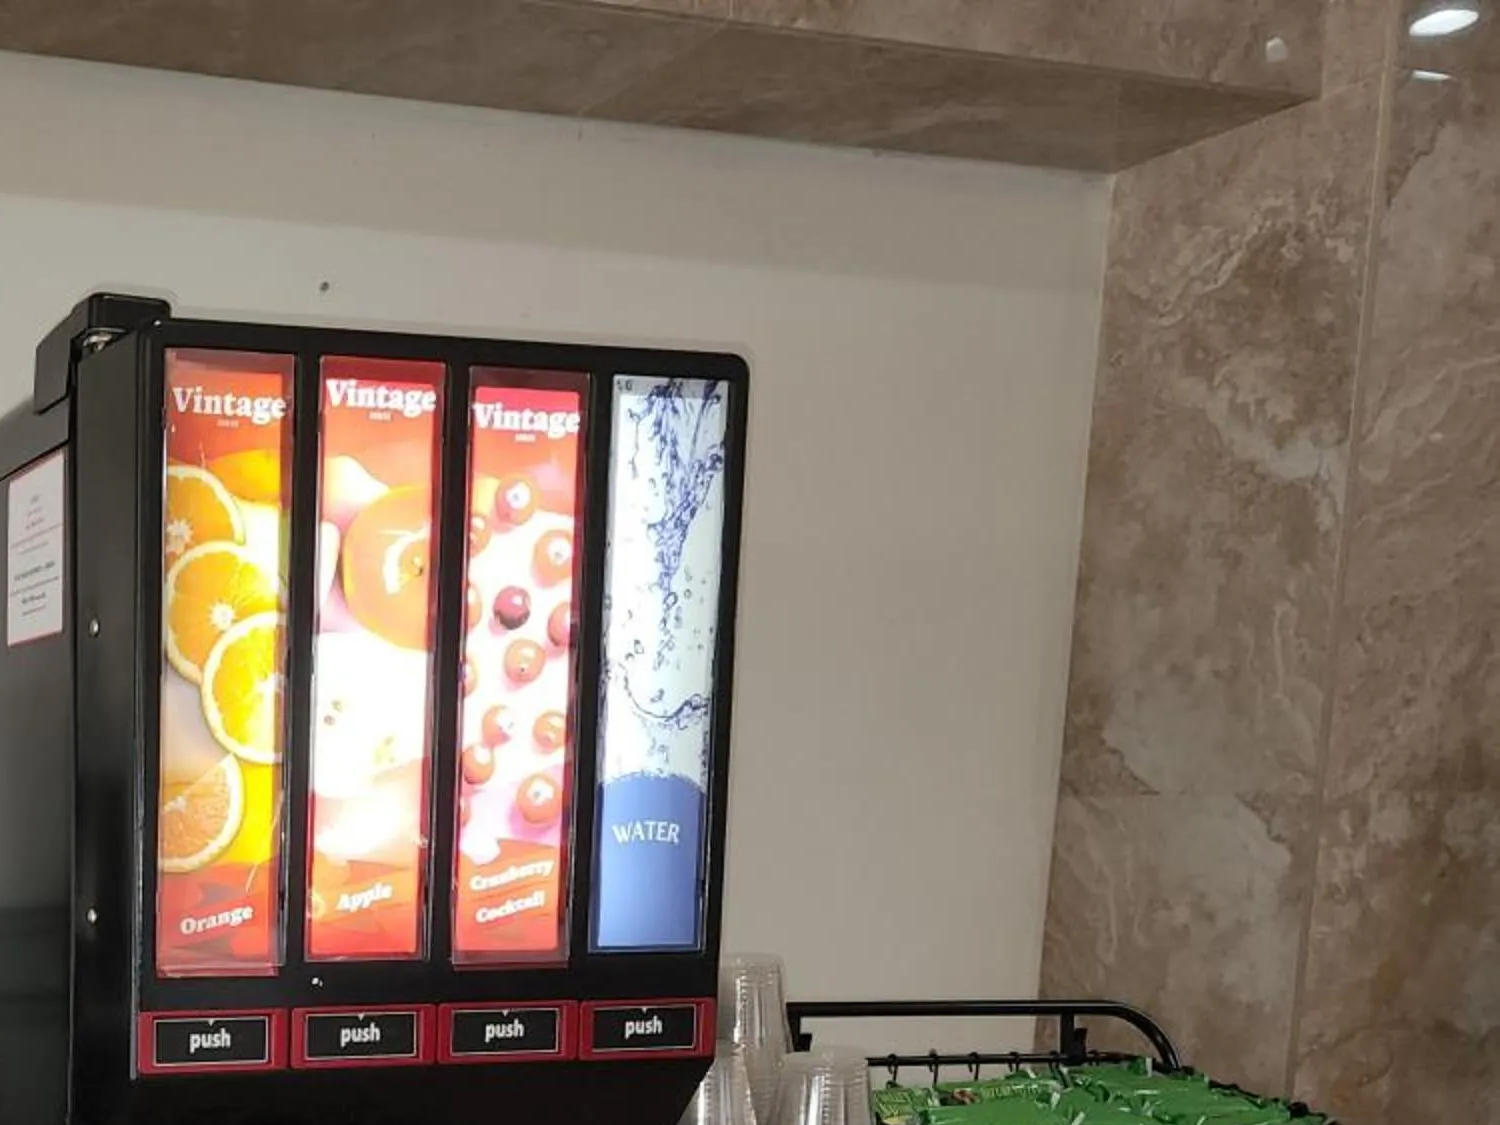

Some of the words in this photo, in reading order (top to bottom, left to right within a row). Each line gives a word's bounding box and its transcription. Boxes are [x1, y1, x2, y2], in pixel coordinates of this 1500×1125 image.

[172, 386, 287, 425] Vintage
[325, 378, 437, 417] Vintage
[473, 402, 580, 437] Vintage
[612, 820, 680, 845] WATER
[470, 860, 555, 891] Cranberry
[336, 882, 393, 913] Apple
[476, 890, 545, 923] Cocktail
[180, 905, 253, 934] Orange
[189, 1027, 231, 1053] push
[340, 1022, 381, 1047] push
[485, 1018, 525, 1043] push
[624, 1015, 662, 1039] push
